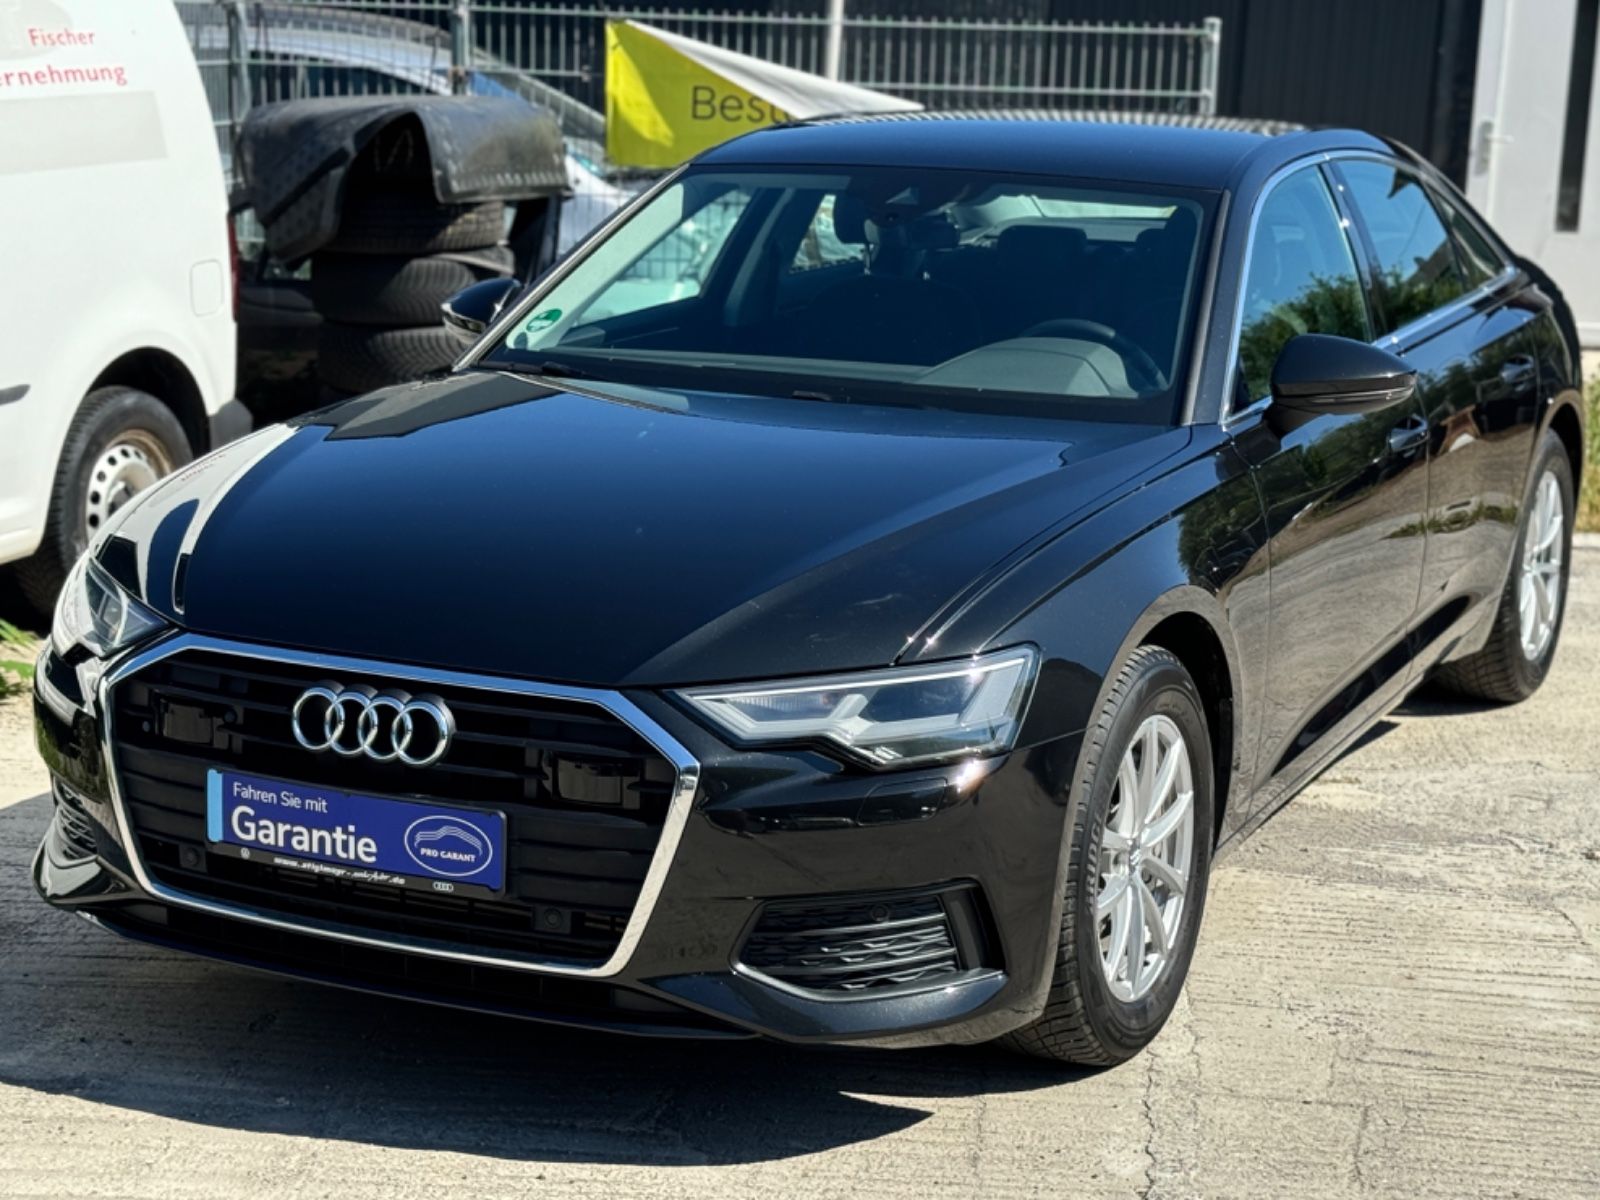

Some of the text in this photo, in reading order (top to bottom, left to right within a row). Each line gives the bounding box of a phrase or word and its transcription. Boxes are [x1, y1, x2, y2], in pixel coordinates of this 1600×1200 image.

[28, 27, 95, 47] Fischer
[233, 781, 328, 813] Fahren Sie mit
[231, 805, 377, 862] Garantie
[420, 847, 476, 862] PRO GARANT
